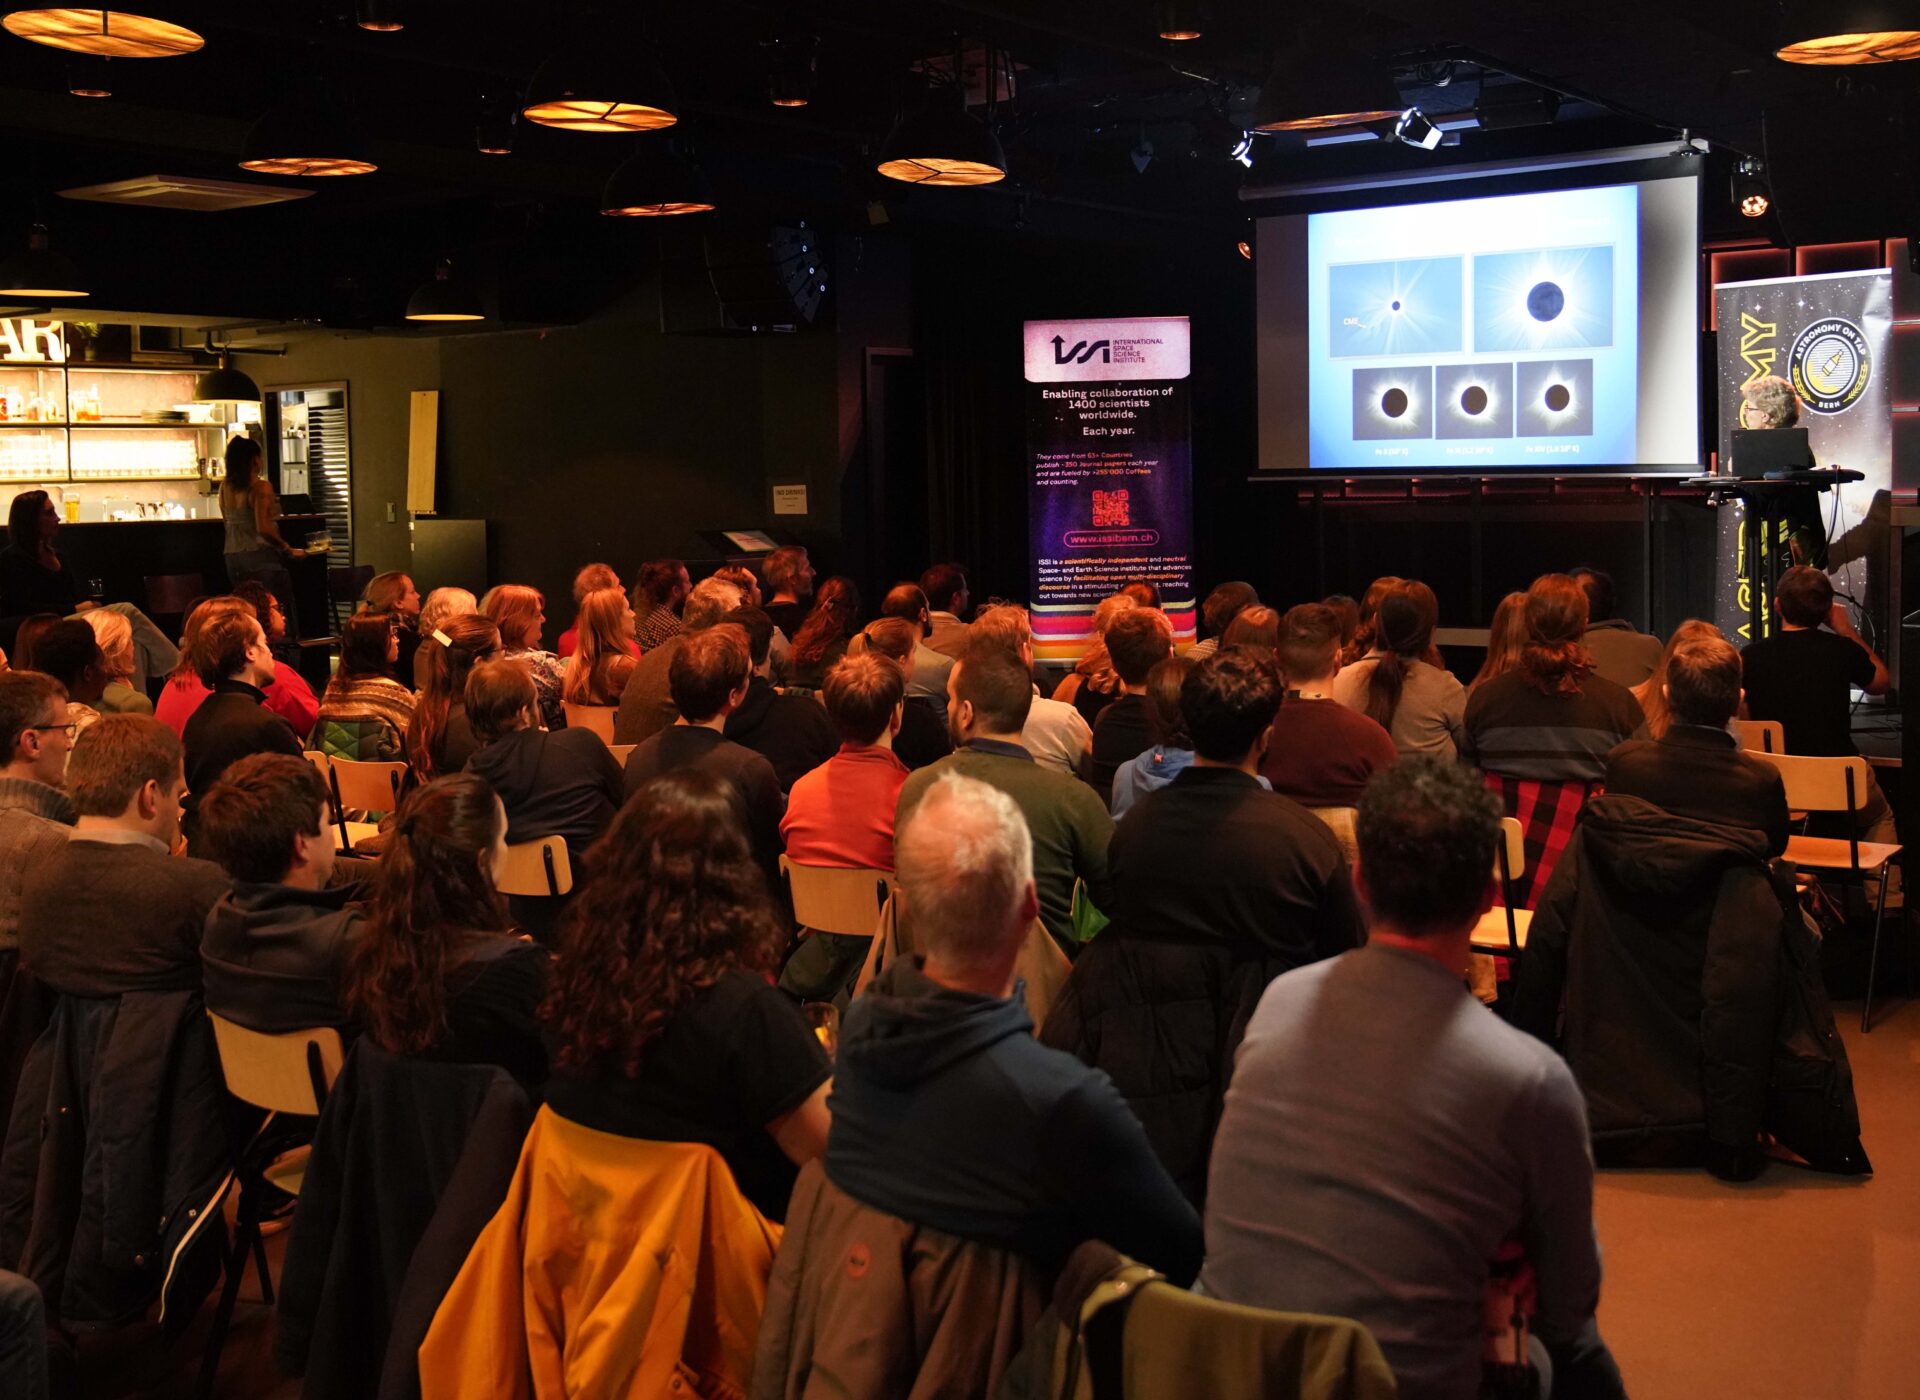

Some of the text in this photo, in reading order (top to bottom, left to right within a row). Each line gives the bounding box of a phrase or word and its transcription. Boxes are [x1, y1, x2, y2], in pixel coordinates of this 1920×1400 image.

[1795, 324, 1866, 360] ASTRONOMY ON TAP
[1042, 387, 1174, 400] Enabling collaboration of
[1069, 399, 1150, 409] 1400 scientists
[1818, 400, 1840, 408] BERN
[1079, 410, 1137, 420] worldwide.
[1082, 426, 1136, 437] Each year.
[1083, 469, 1090, 477] by
[1070, 534, 1153, 544] www.issibern.ch
